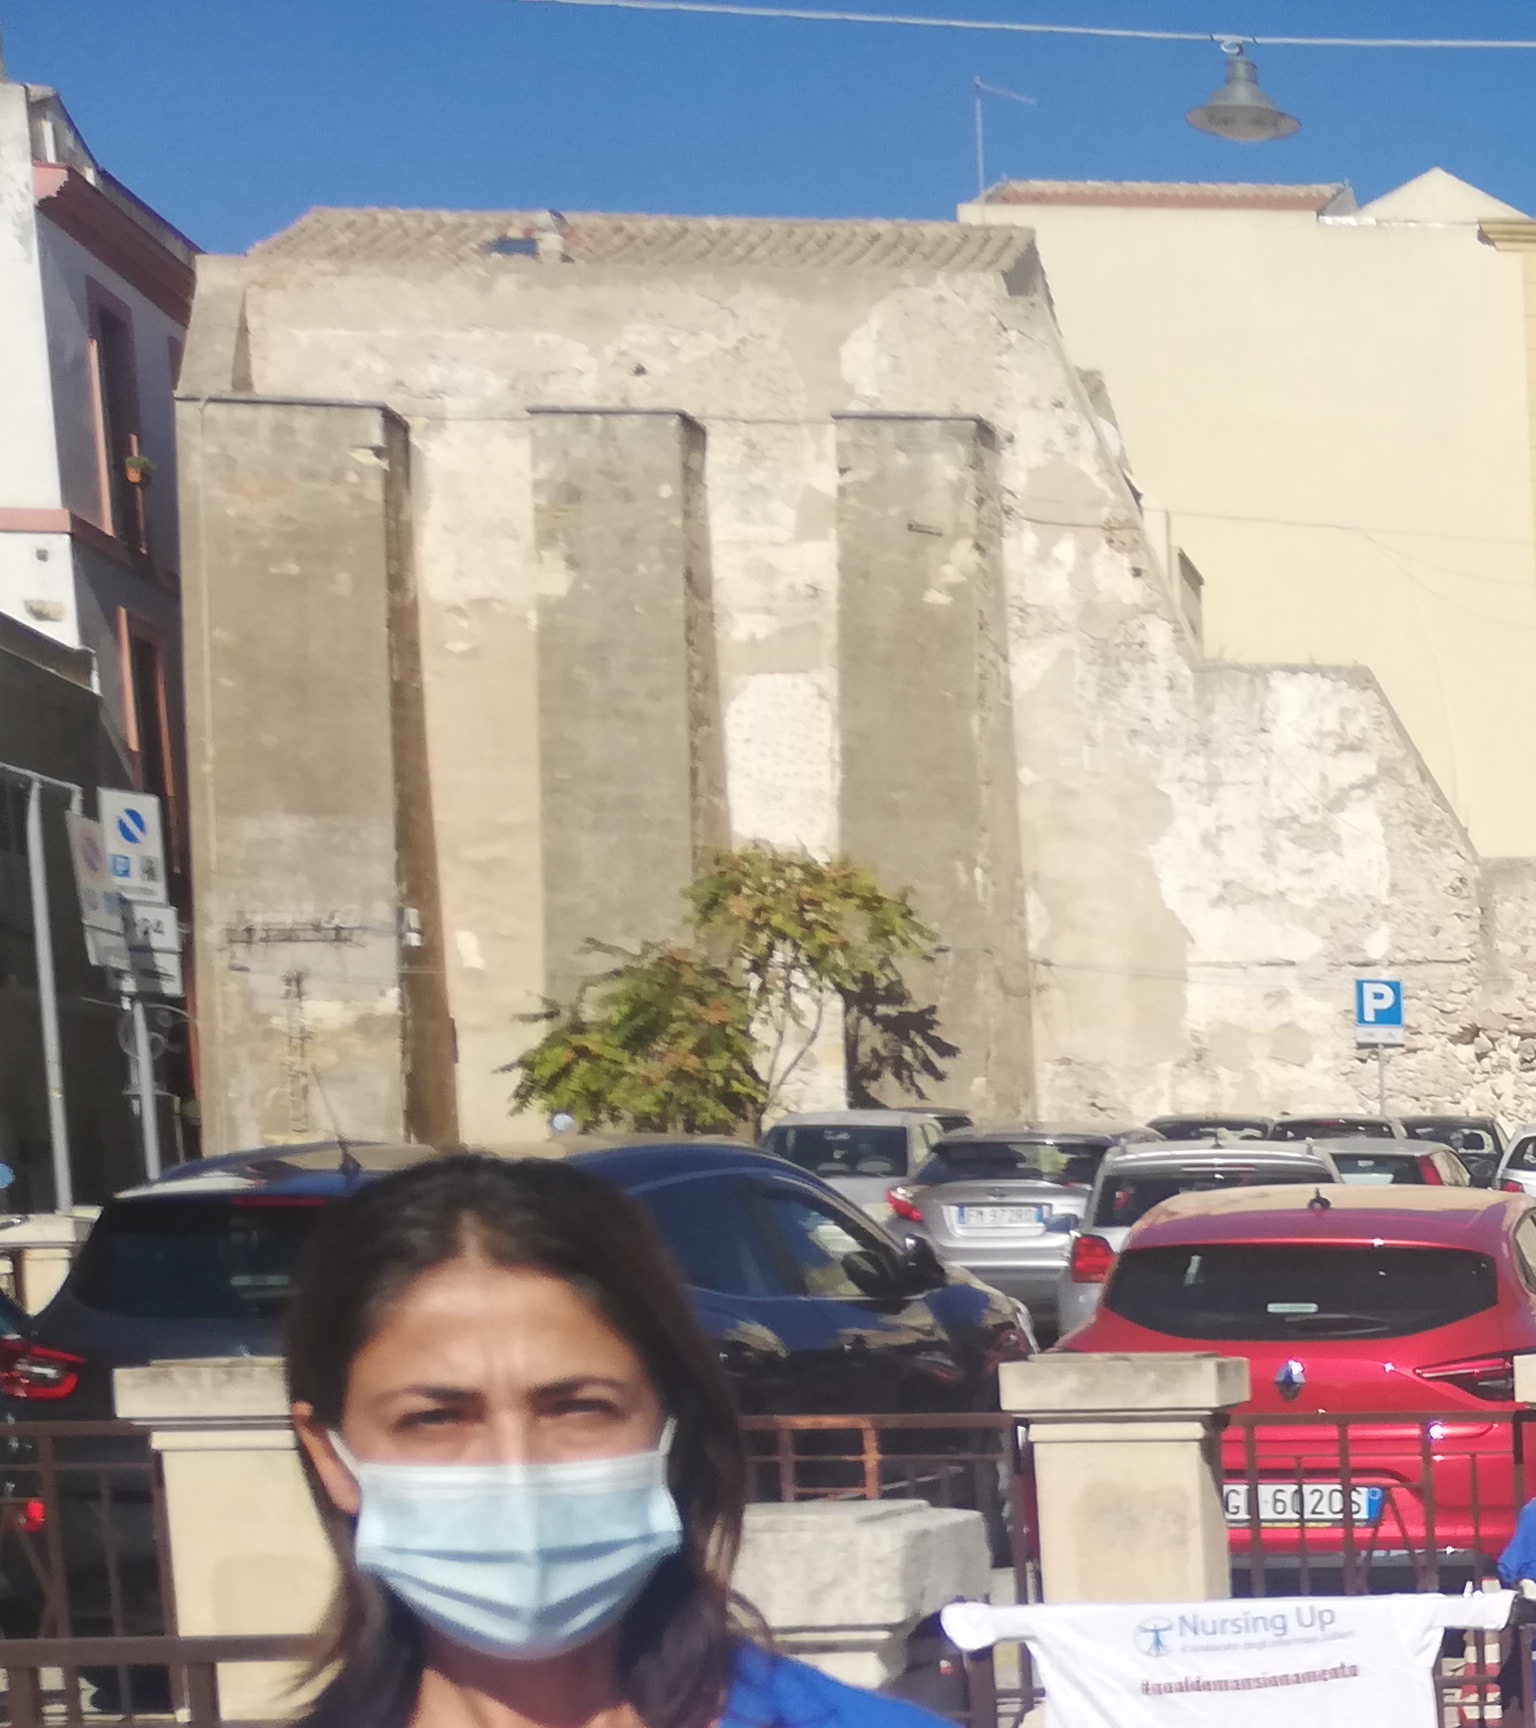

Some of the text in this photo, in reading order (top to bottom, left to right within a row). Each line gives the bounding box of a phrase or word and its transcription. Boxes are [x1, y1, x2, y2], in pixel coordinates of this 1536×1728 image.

[1362, 982, 1395, 1022] P
[1178, 1605, 1337, 1637] Nursing Up
